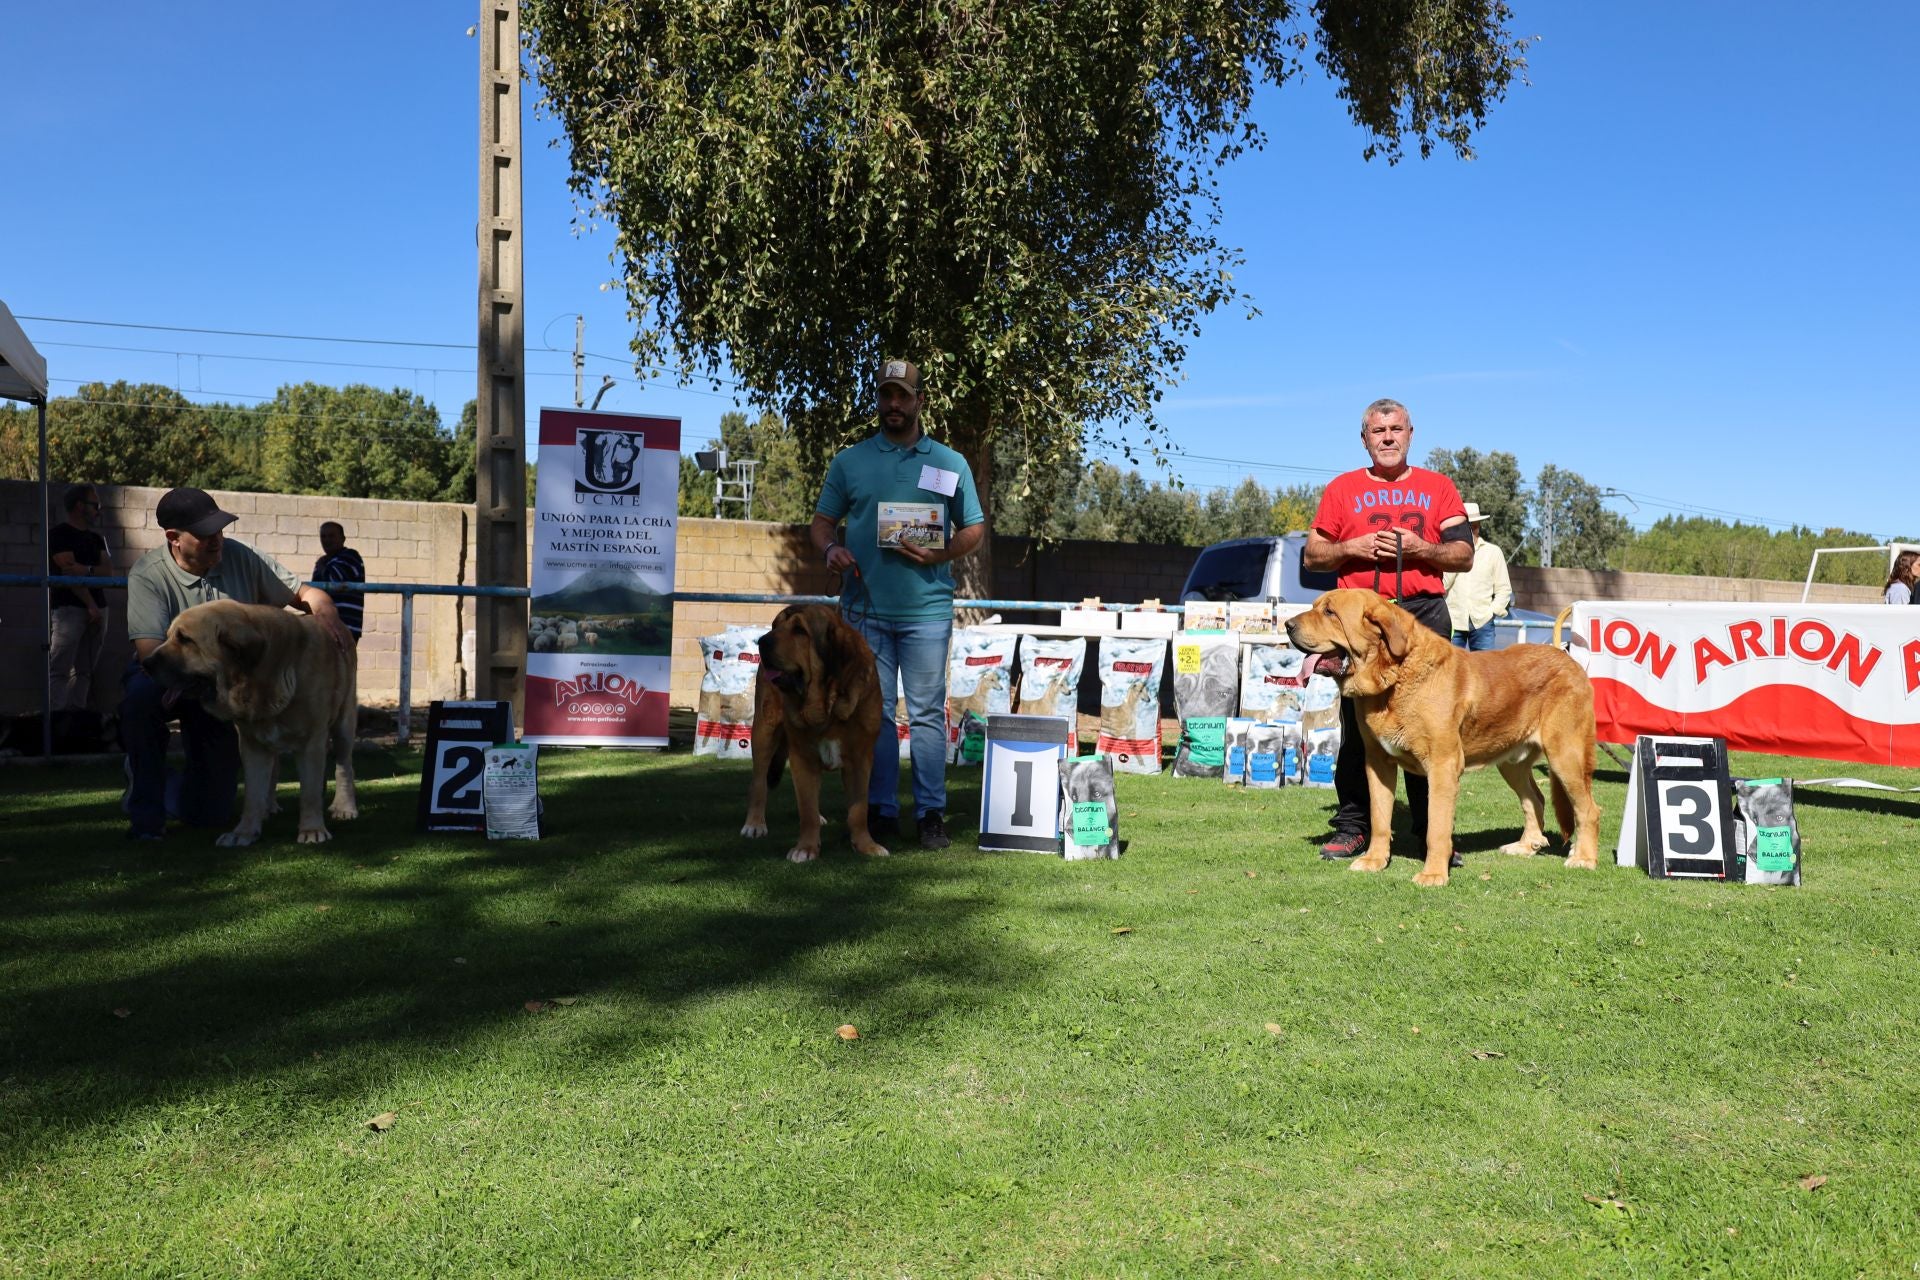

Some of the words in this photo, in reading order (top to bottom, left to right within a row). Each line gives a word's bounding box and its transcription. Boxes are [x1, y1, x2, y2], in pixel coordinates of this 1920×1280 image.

[575, 493, 640, 507] UCME
[1354, 489, 1431, 513] JORDAN
[541, 512, 586, 524] UNIÓN
[590, 515, 620, 526] PARA
[624, 516, 640, 526] LA
[642, 515, 672, 528] CRÍA
[560, 528, 569, 537] Y
[572, 528, 622, 540] MEJORA
[626, 530, 652, 540] DEL
[550, 541, 599, 553] MASTÍN
[603, 542, 661, 555] ESPAÑOL
[546, 560, 597, 569] www.ucme.es
[1691, 617, 1884, 689] ARION
[556, 672, 647, 706] ARION
[1189, 722, 1225, 730] titanium
[436, 745, 484, 810] 2
[1011, 760, 1034, 827] 1
[1665, 784, 1715, 855] 3
